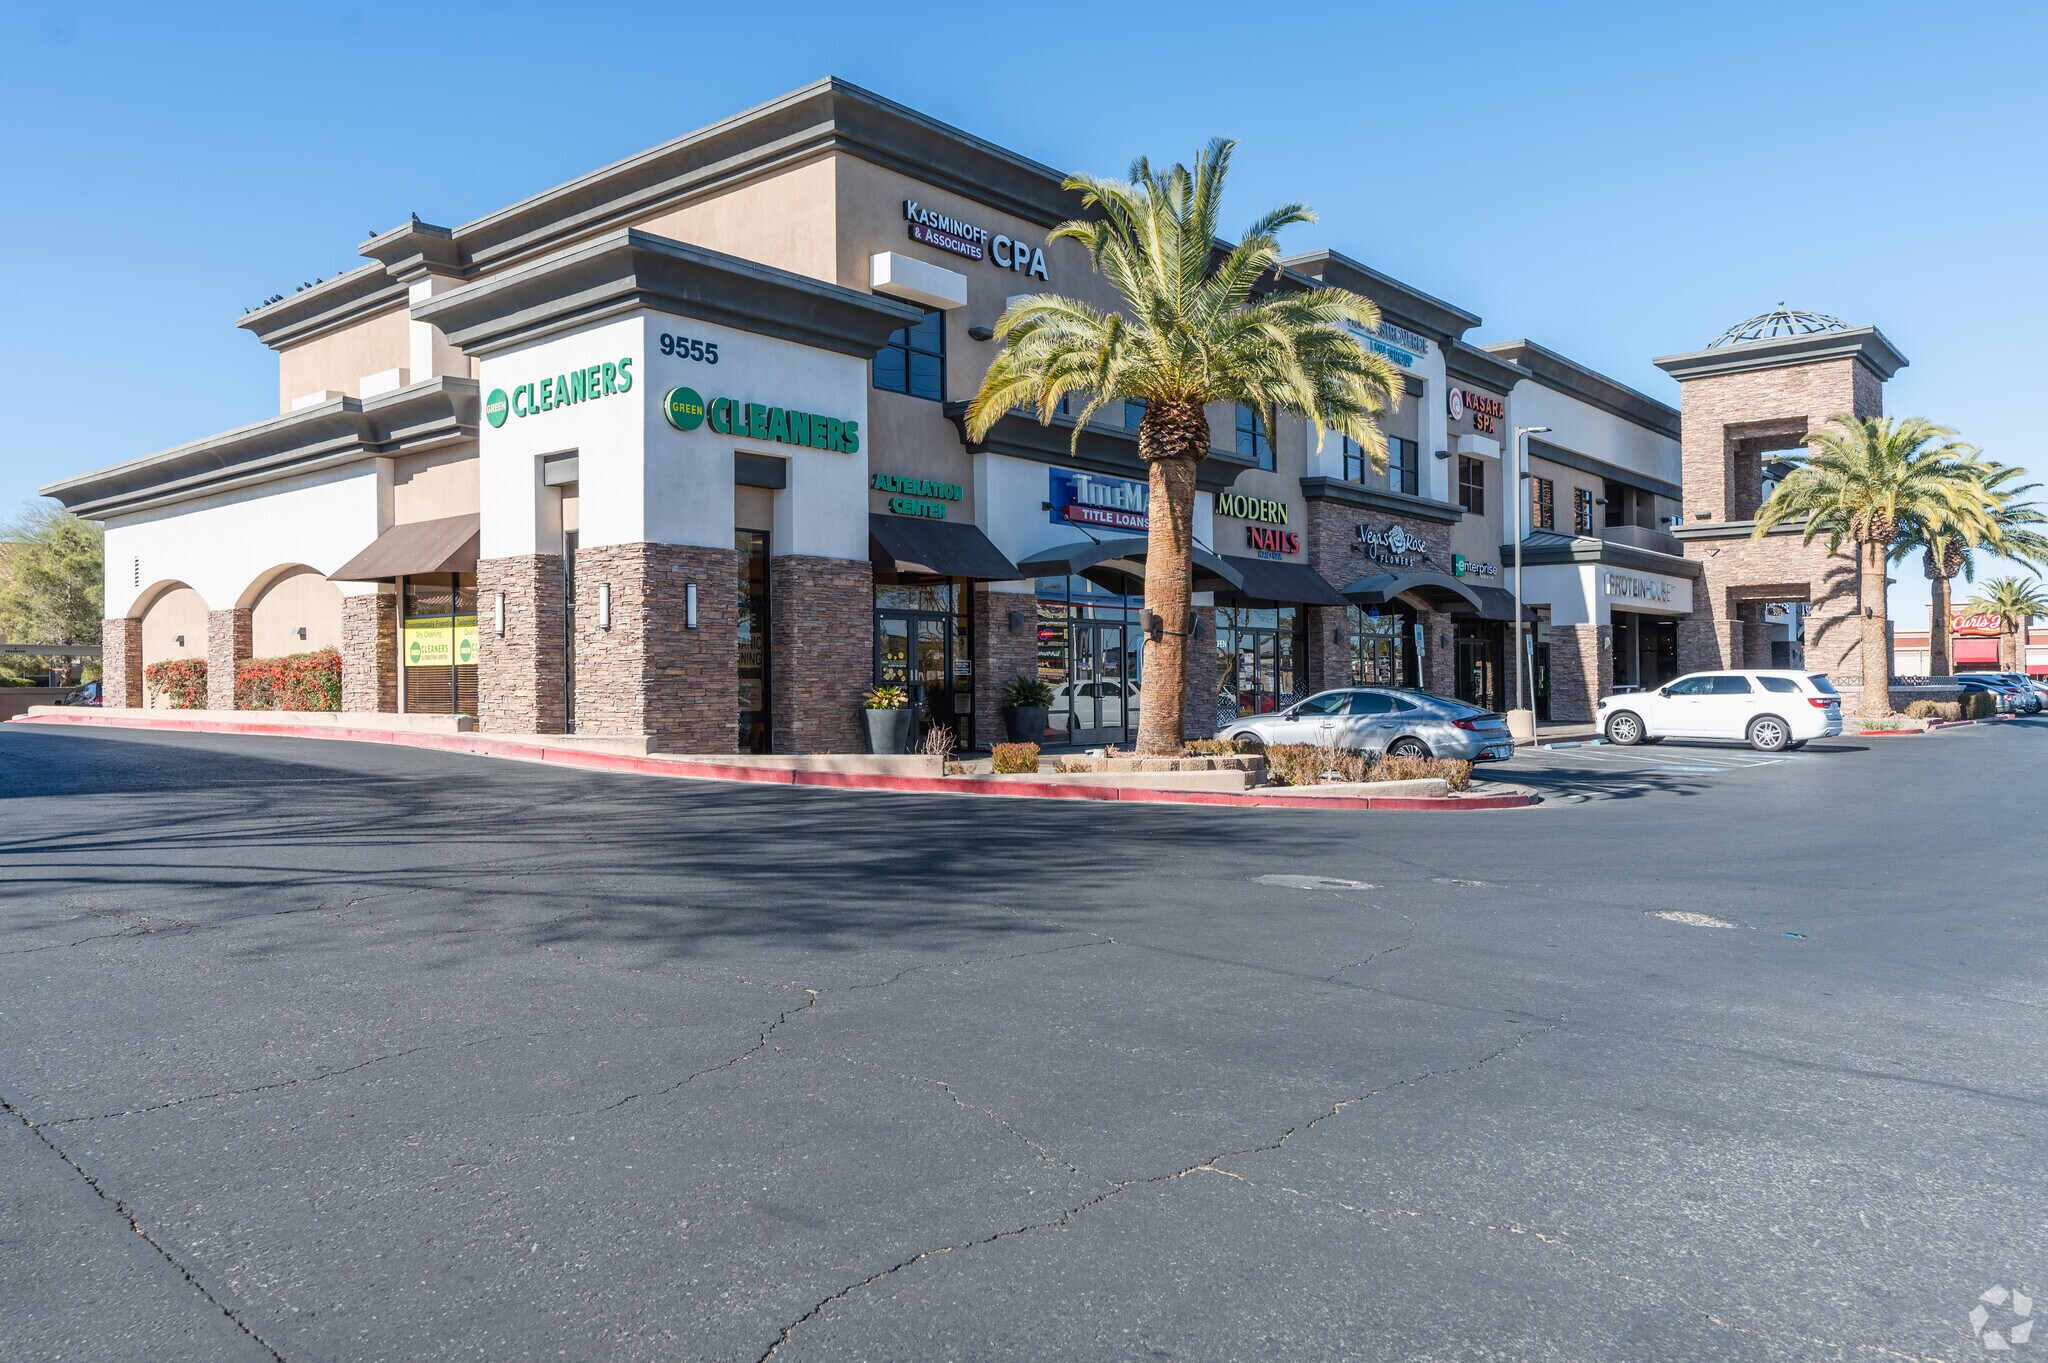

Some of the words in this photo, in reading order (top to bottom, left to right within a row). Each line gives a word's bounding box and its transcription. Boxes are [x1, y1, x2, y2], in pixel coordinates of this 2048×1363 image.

[906, 199, 988, 245] KASMINOFF
[914, 226, 922, 239] &
[925, 228, 982, 259] ASSOCIATES
[991, 234, 1049, 281] CPA
[660, 333, 719, 365] 9555
[1387, 347, 1414, 367] GROUP
[486, 401, 507, 414] GREEN
[511, 357, 633, 418] CLEANERS
[1464, 390, 1505, 419] KASARA
[672, 401, 703, 416] GREEN
[708, 396, 860, 454] CLEANERS
[1476, 412, 1496, 433] SPA
[873, 473, 963, 501] ALTERATION
[889, 497, 947, 519] CENTER
[1082, 508, 1114, 523] TITLE
[1116, 514, 1150, 529] LOANS
[1218, 491, 1289, 525] MODERN
[1250, 526, 1300, 554] NAILS
[1357, 524, 1389, 559] Vegas
[1404, 532, 1427, 553] Rose
[1380, 554, 1414, 567] FLOWERS
[1457, 559, 1498, 576] enterprise
[1952, 614, 1989, 630] Carl's
[421, 644, 448, 653] CLEANERS
